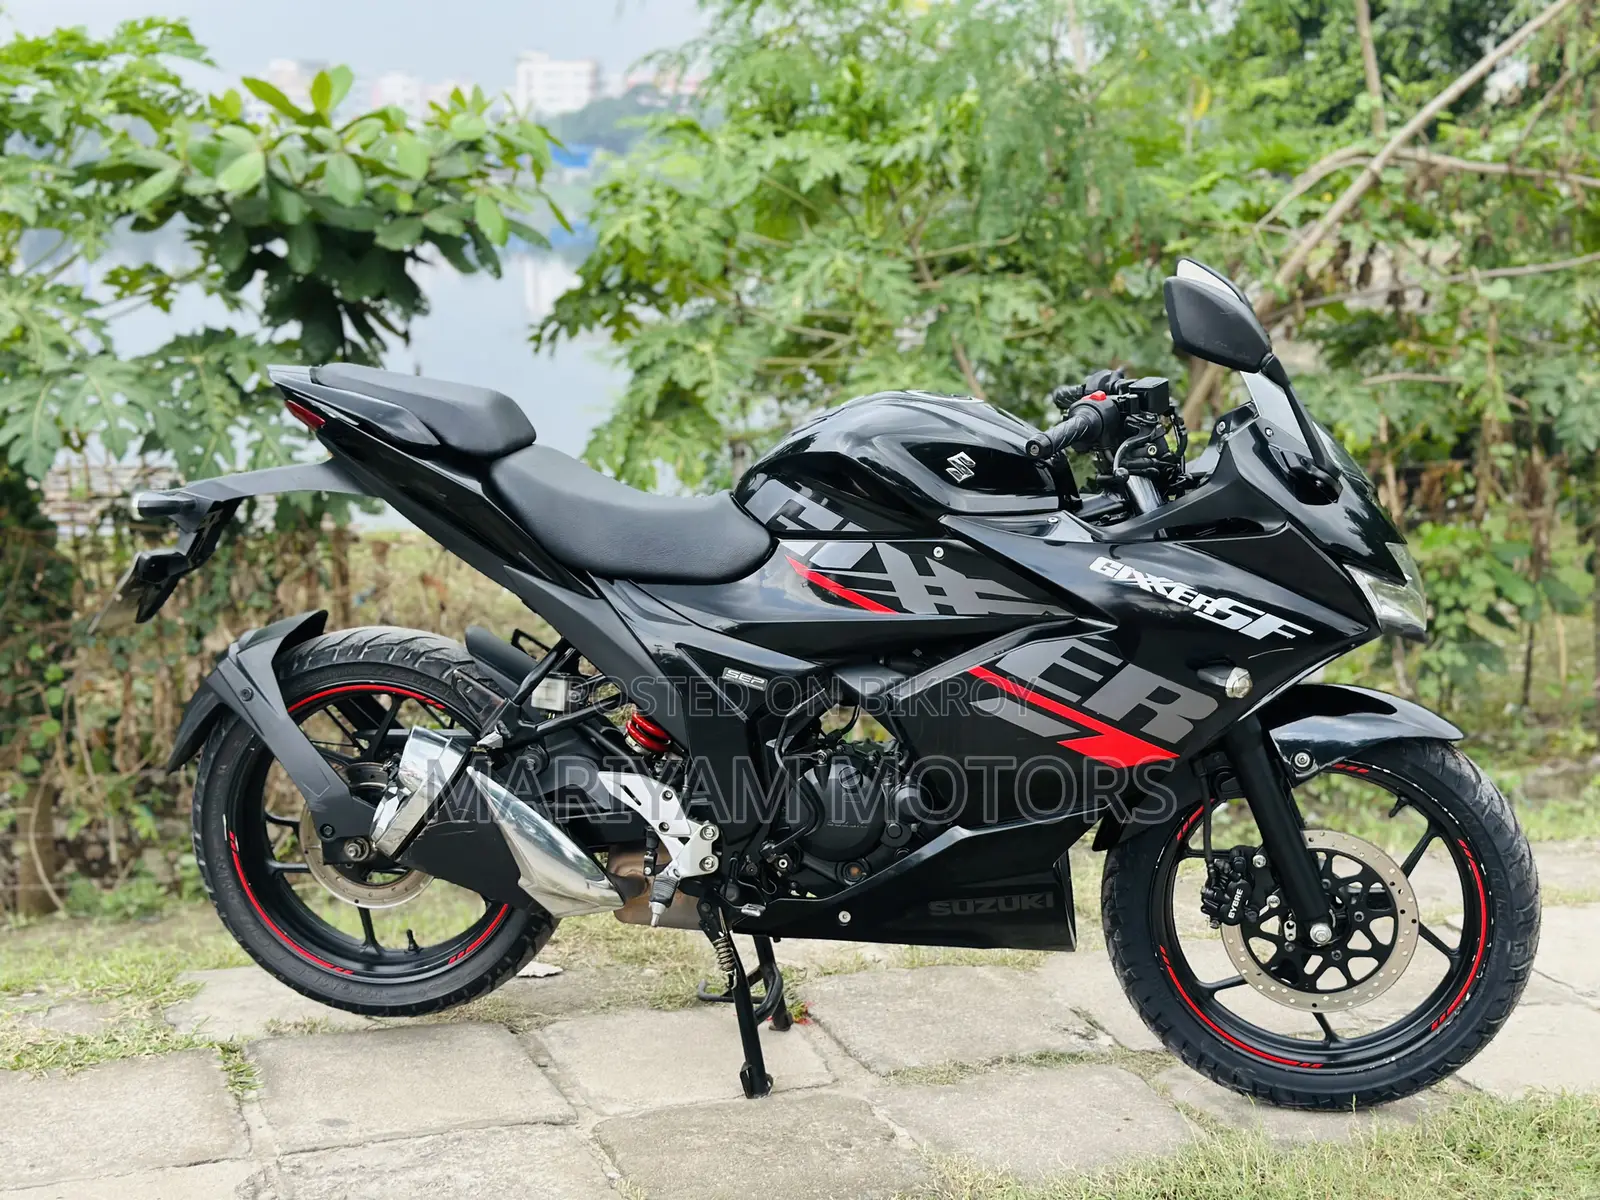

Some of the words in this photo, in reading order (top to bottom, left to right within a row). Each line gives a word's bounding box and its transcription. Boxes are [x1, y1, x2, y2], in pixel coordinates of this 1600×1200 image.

[725, 668, 766, 685] SEP
[928, 891, 1054, 916] SUZUKI
[1228, 888, 1244, 919] BYBRE
